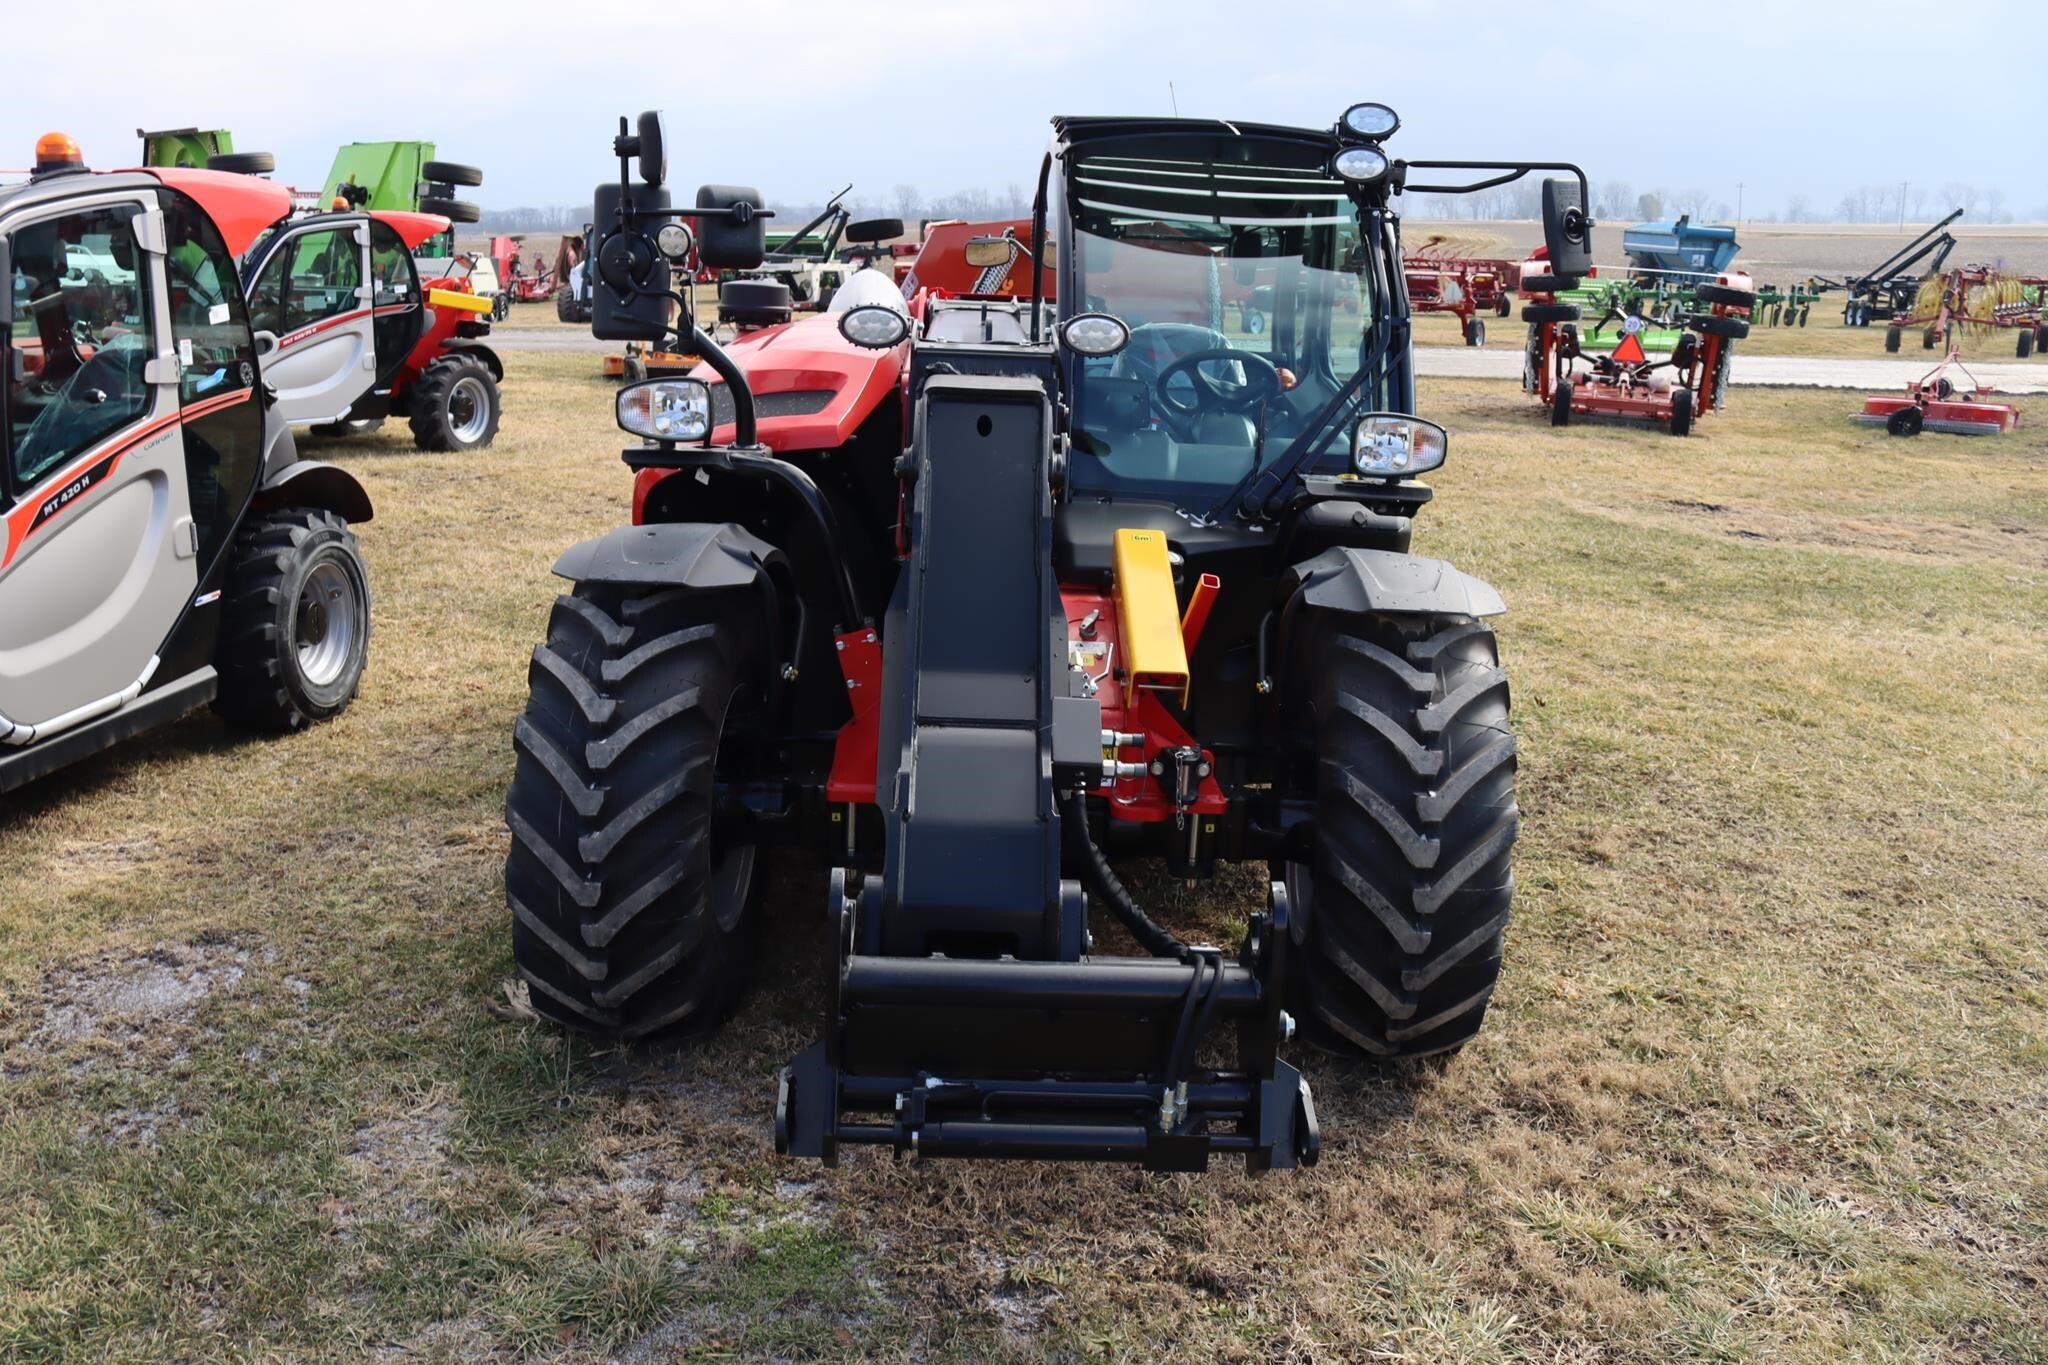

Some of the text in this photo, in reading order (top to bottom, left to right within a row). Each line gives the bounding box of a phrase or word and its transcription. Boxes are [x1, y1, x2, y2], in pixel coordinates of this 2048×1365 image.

[43, 475, 90, 517] MT 420 H
